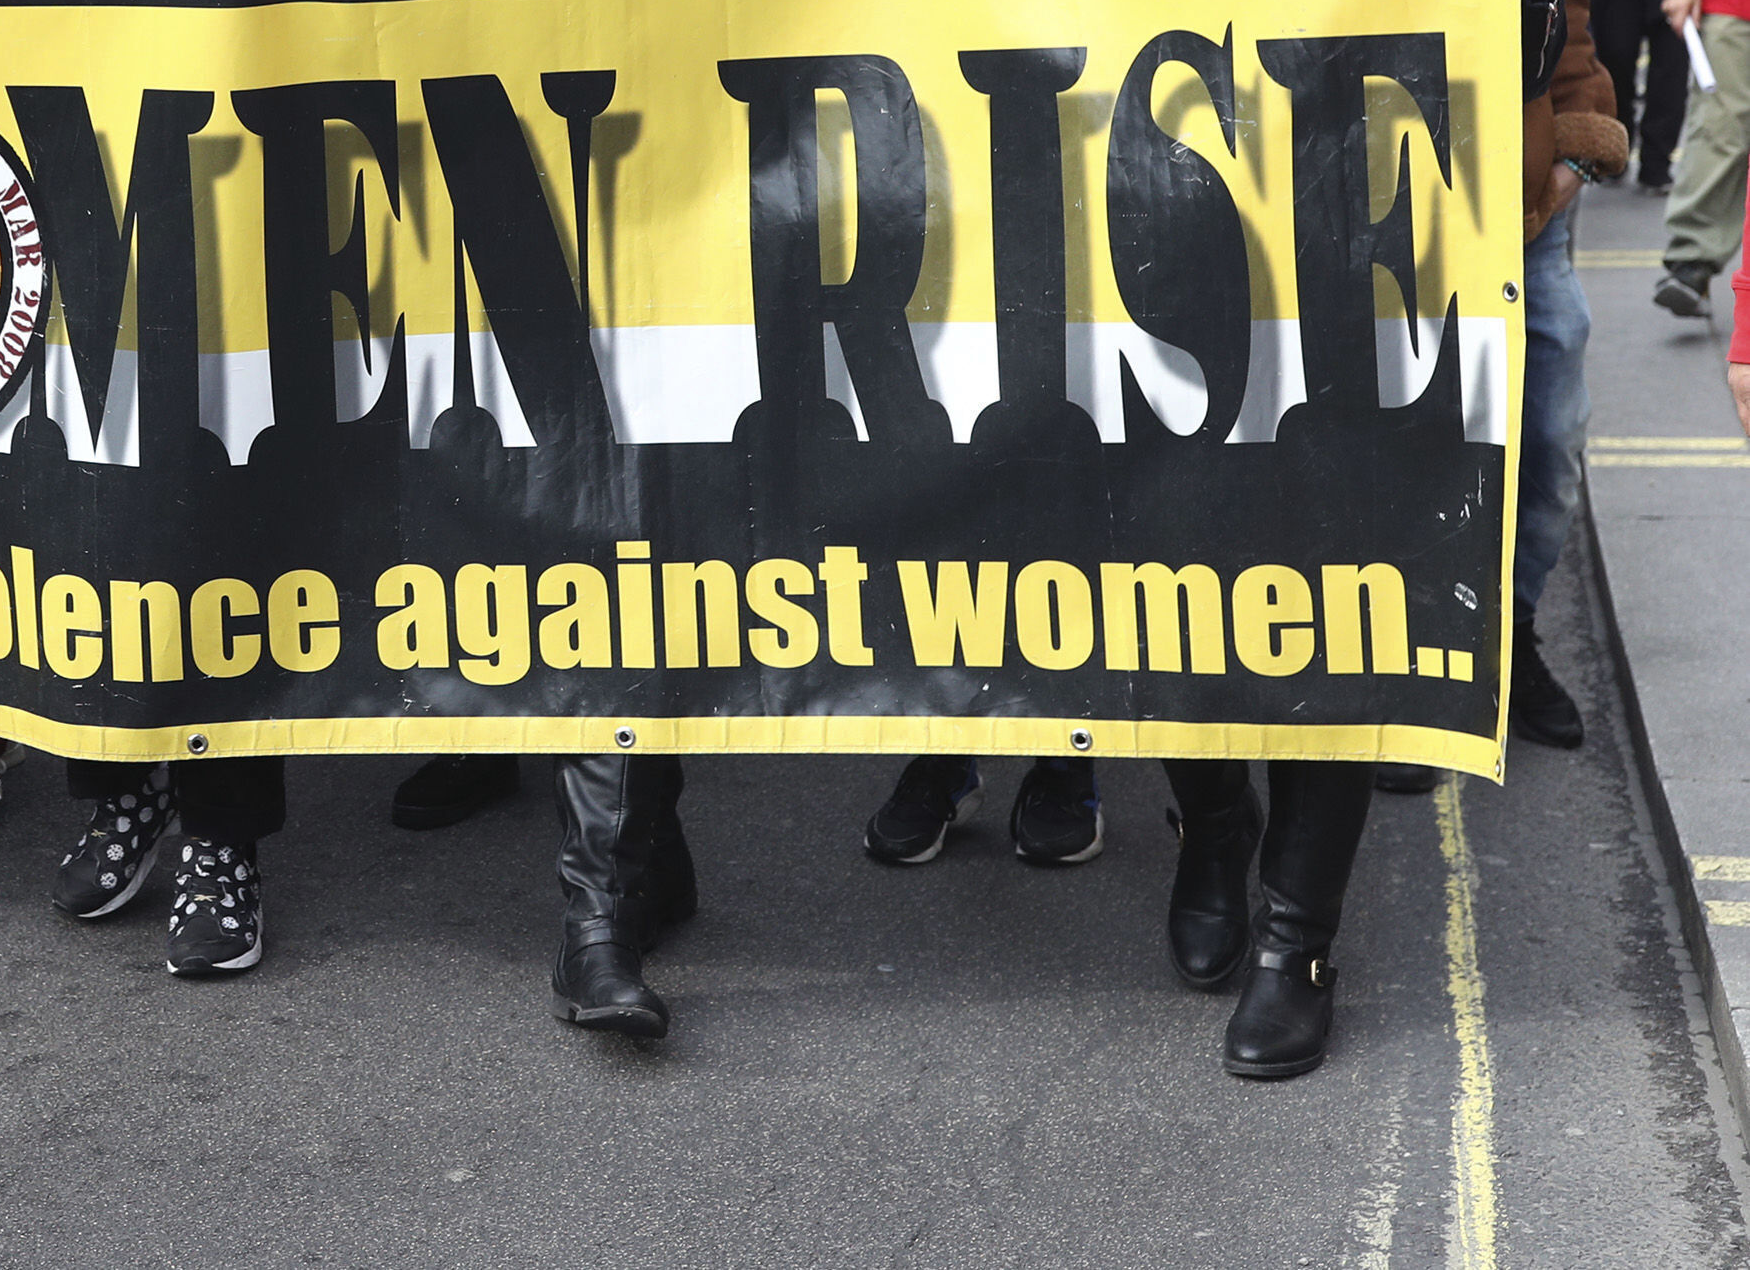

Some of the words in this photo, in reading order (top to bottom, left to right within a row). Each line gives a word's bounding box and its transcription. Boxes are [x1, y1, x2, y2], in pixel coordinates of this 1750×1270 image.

[717, 21, 1464, 444] RISE
[375, 541, 875, 686] against
[896, 559, 1475, 683] women..
